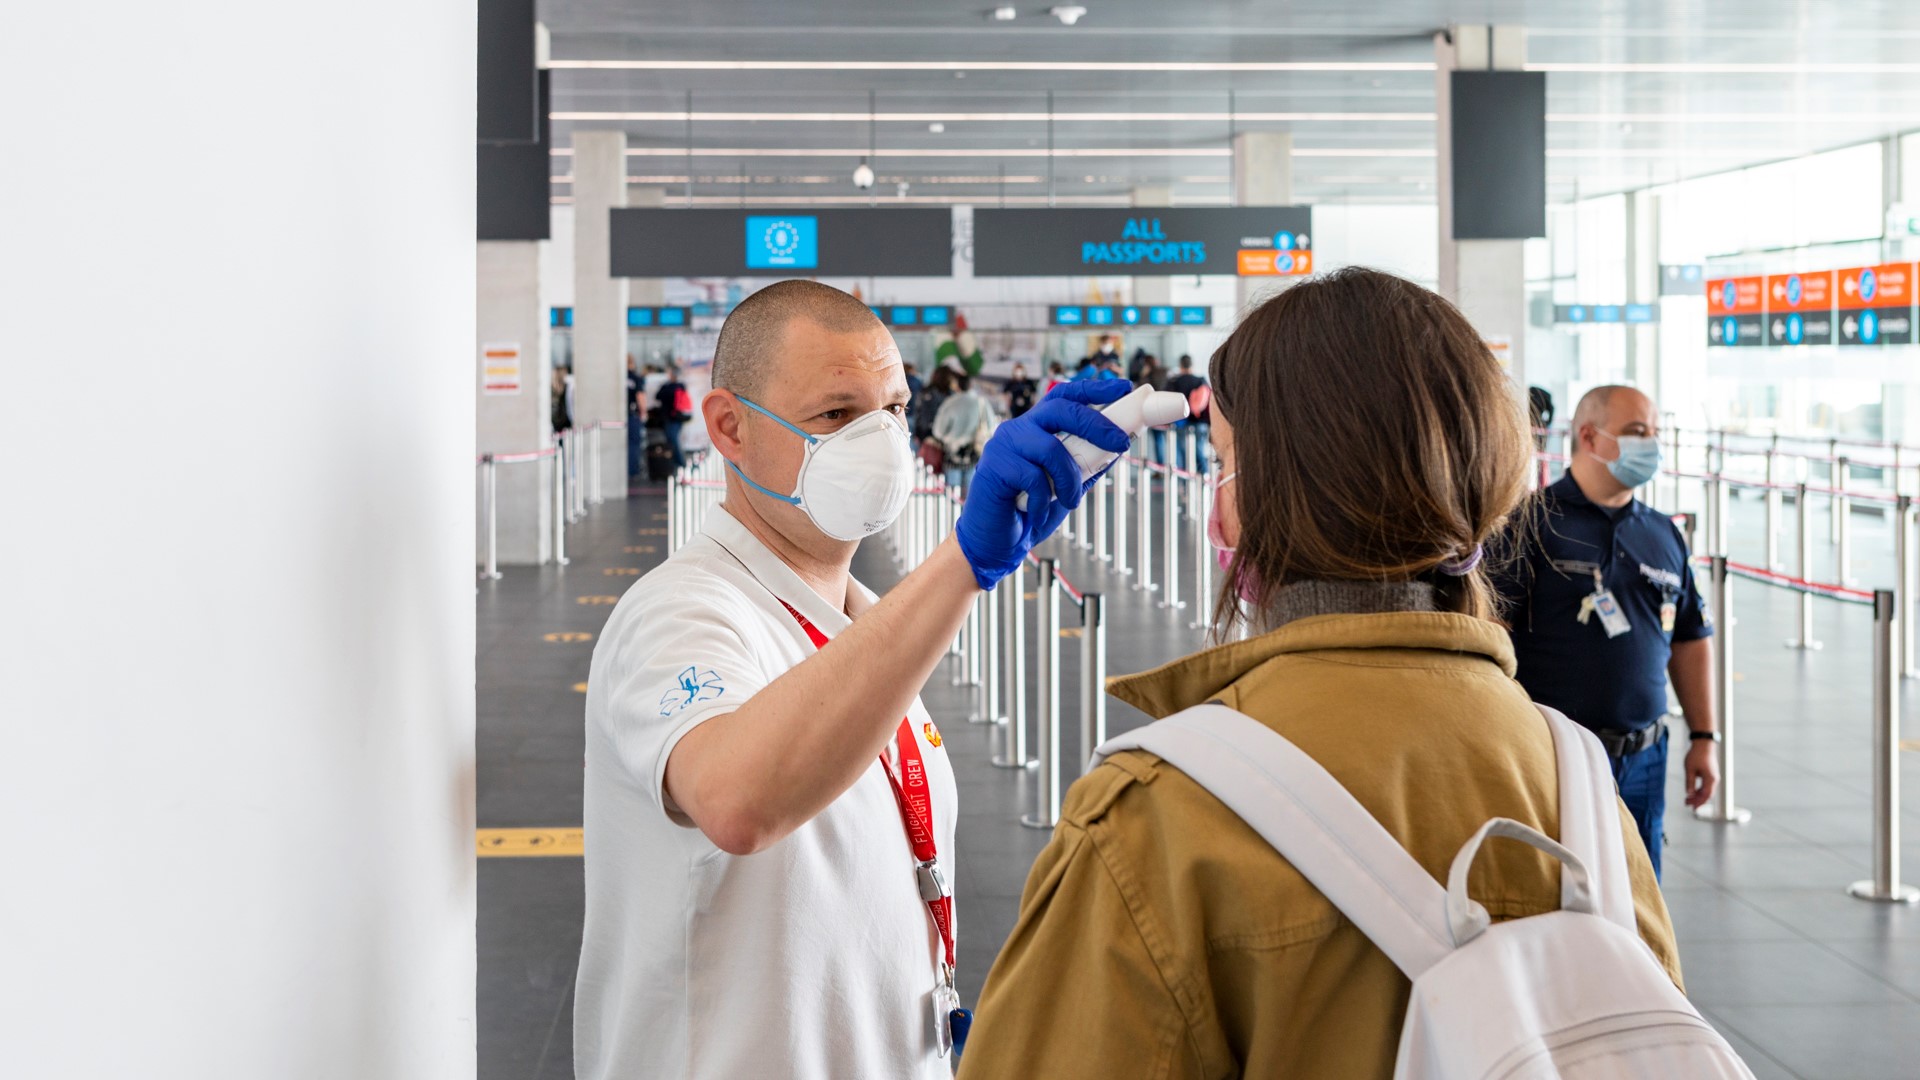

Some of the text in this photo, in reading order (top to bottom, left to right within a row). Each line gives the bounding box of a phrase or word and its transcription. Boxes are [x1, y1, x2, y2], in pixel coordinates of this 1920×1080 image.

[1122, 219, 1165, 239] ALL
[1082, 242, 1205, 263] PASSPORTS
[907, 759, 923, 787] CREW
[906, 807, 928, 844] FLIGHT
[933, 904, 948, 936] REMOVE
